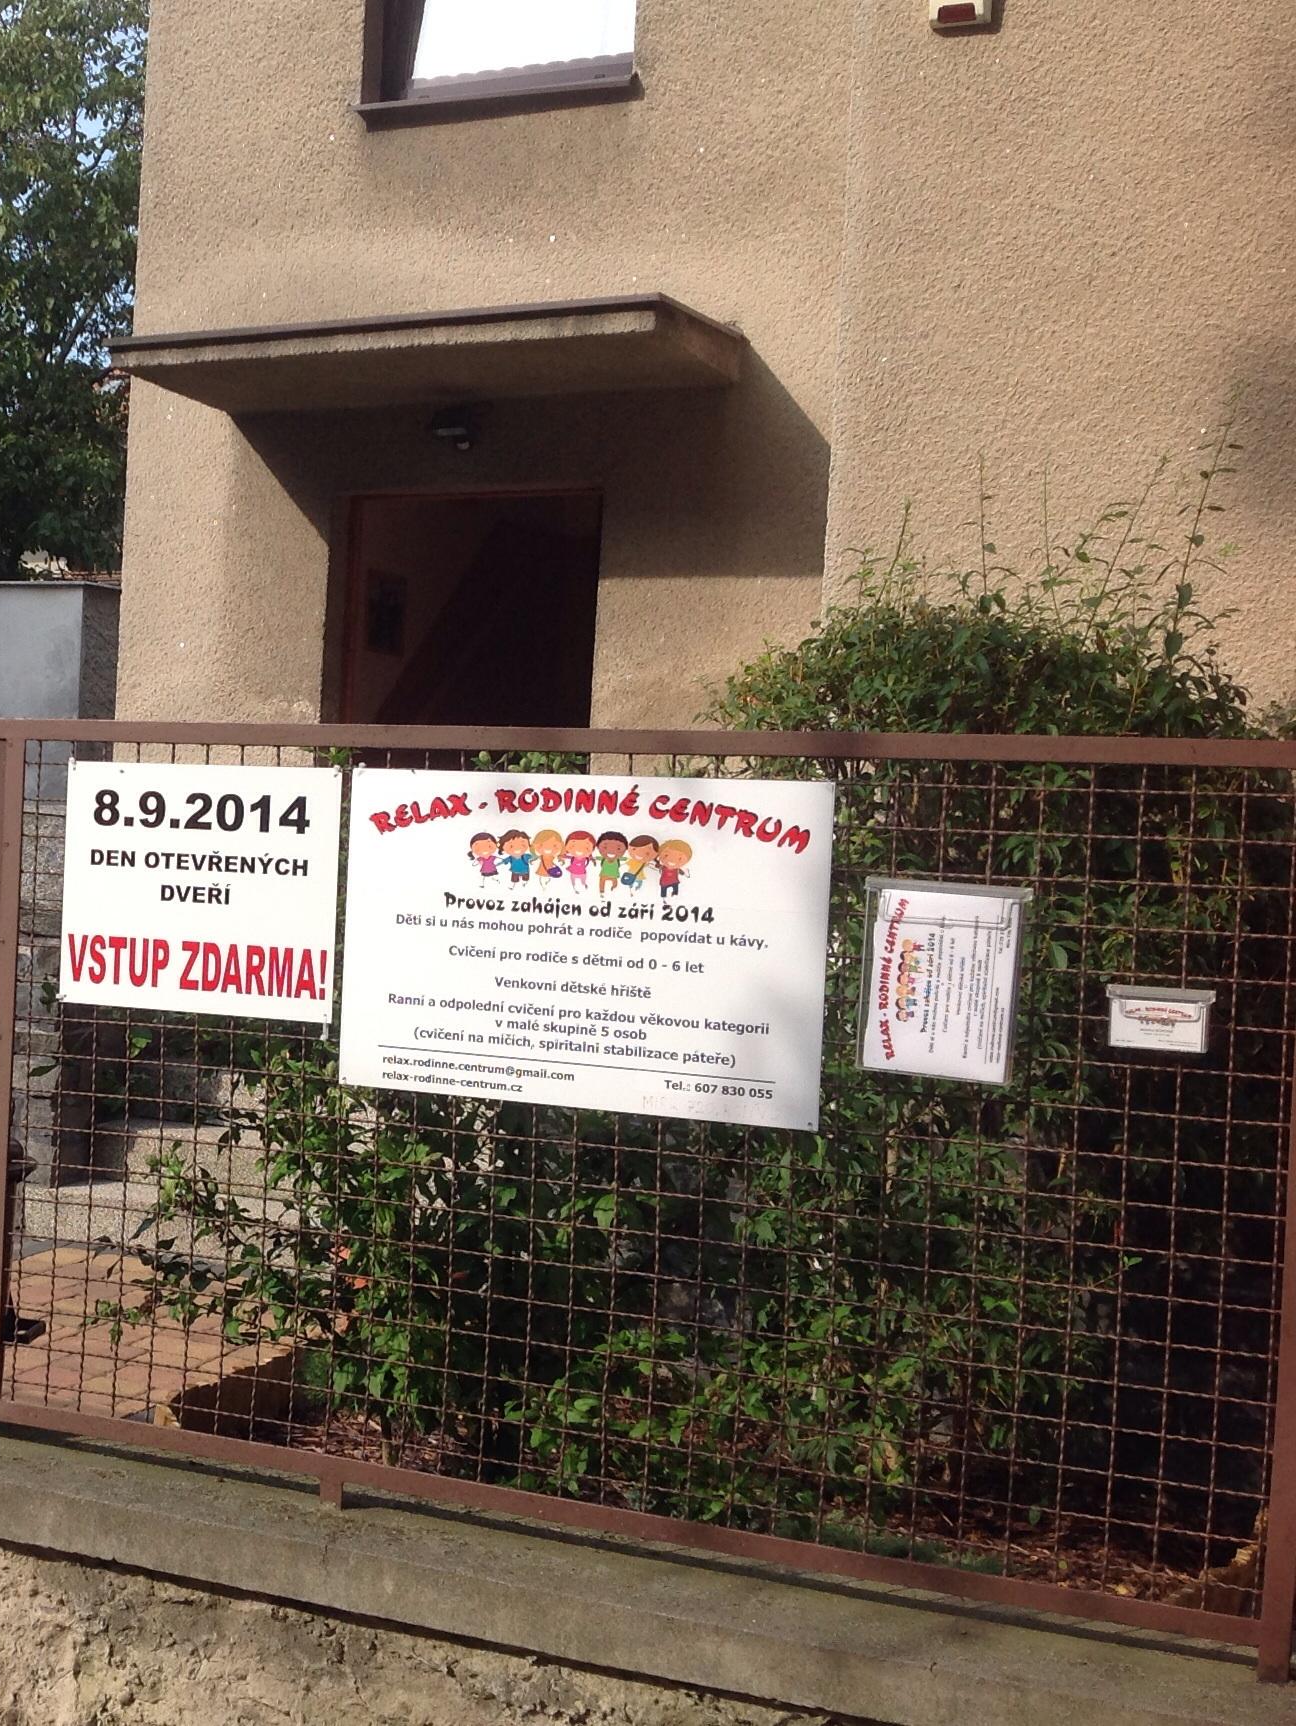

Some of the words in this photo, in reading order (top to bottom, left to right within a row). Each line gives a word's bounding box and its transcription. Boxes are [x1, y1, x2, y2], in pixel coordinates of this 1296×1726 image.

[93, 789, 310, 834] 8.9.2014
[369, 792, 472, 835] RELAX
[495, 784, 640, 817] RODINNÉ
[649, 795, 811, 854] CENTRUM
[90, 849, 137, 868] DEN
[144, 851, 309, 877] OTEVŘENÝCH
[160, 883, 231, 905] DVEŘÍ
[444, 891, 505, 912] Provoz
[511, 896, 582, 918] zahájen
[589, 901, 612, 918] od
[618, 903, 655, 920] září
[661, 903, 715, 923] 2014
[396, 914, 422, 926] Děti
[425, 915, 436, 926] si
[440, 918, 448, 927] u
[452, 917, 475, 929] nás
[479, 919, 524, 932] mohou
[527, 922, 573, 936] pohrát
[576, 928, 585, 936] a
[589, 926, 632, 939] rodiče
[640, 930, 713, 945] popovídat
[717, 937, 725, 946] u
[730, 934, 769, 951] kávy.
[68, 933, 170, 988] VSTUP
[179, 941, 328, 1001] ZDARMA!
[448, 945, 496, 959] Cvičení
[499, 951, 522, 962] pro
[526, 951, 567, 964] rodiče
[571, 956, 579, 965] s
[582, 954, 623, 967] dětmi
[627, 958, 644, 969] od
[648, 959, 657, 970] 0
[672, 961, 681, 972] 6
[685, 962, 705, 974] let
[494, 976, 557, 992] Venkovní
[560, 980, 607, 996] dětské
[611, 984, 651, 999] hřiště
[428, 998, 436, 1007] a
[440, 998, 504, 1013] odpolední
[508, 1003, 554, 1017] cvičení
[558, 1009, 581, 1020] pro
[585, 1008, 635, 1023] každou
[640, 1013, 700, 1029] věkovou
[704, 1019, 770, 1035] kategorii
[495, 1019, 503, 1028] v
[507, 1018, 540, 1032] malé
[543, 1022, 597, 1037] skupině
[601, 1026, 610, 1037] 5
[614, 1028, 647, 1040] osob
[413, 1026, 464, 1042] (cvičení
[468, 1034, 484, 1043] na
[603, 1044, 679, 1061] stabilizace
[682, 1050, 736, 1068] páteře)
[382, 1055, 575, 1082] relax.rodinne.centrum@gmail.com
[382, 1070, 523, 1092] relax-rodinne-centrum.cz
[694, 1082, 718, 1094] 607
[721, 1085, 745, 1097] 830
[749, 1088, 773, 1100] 055
